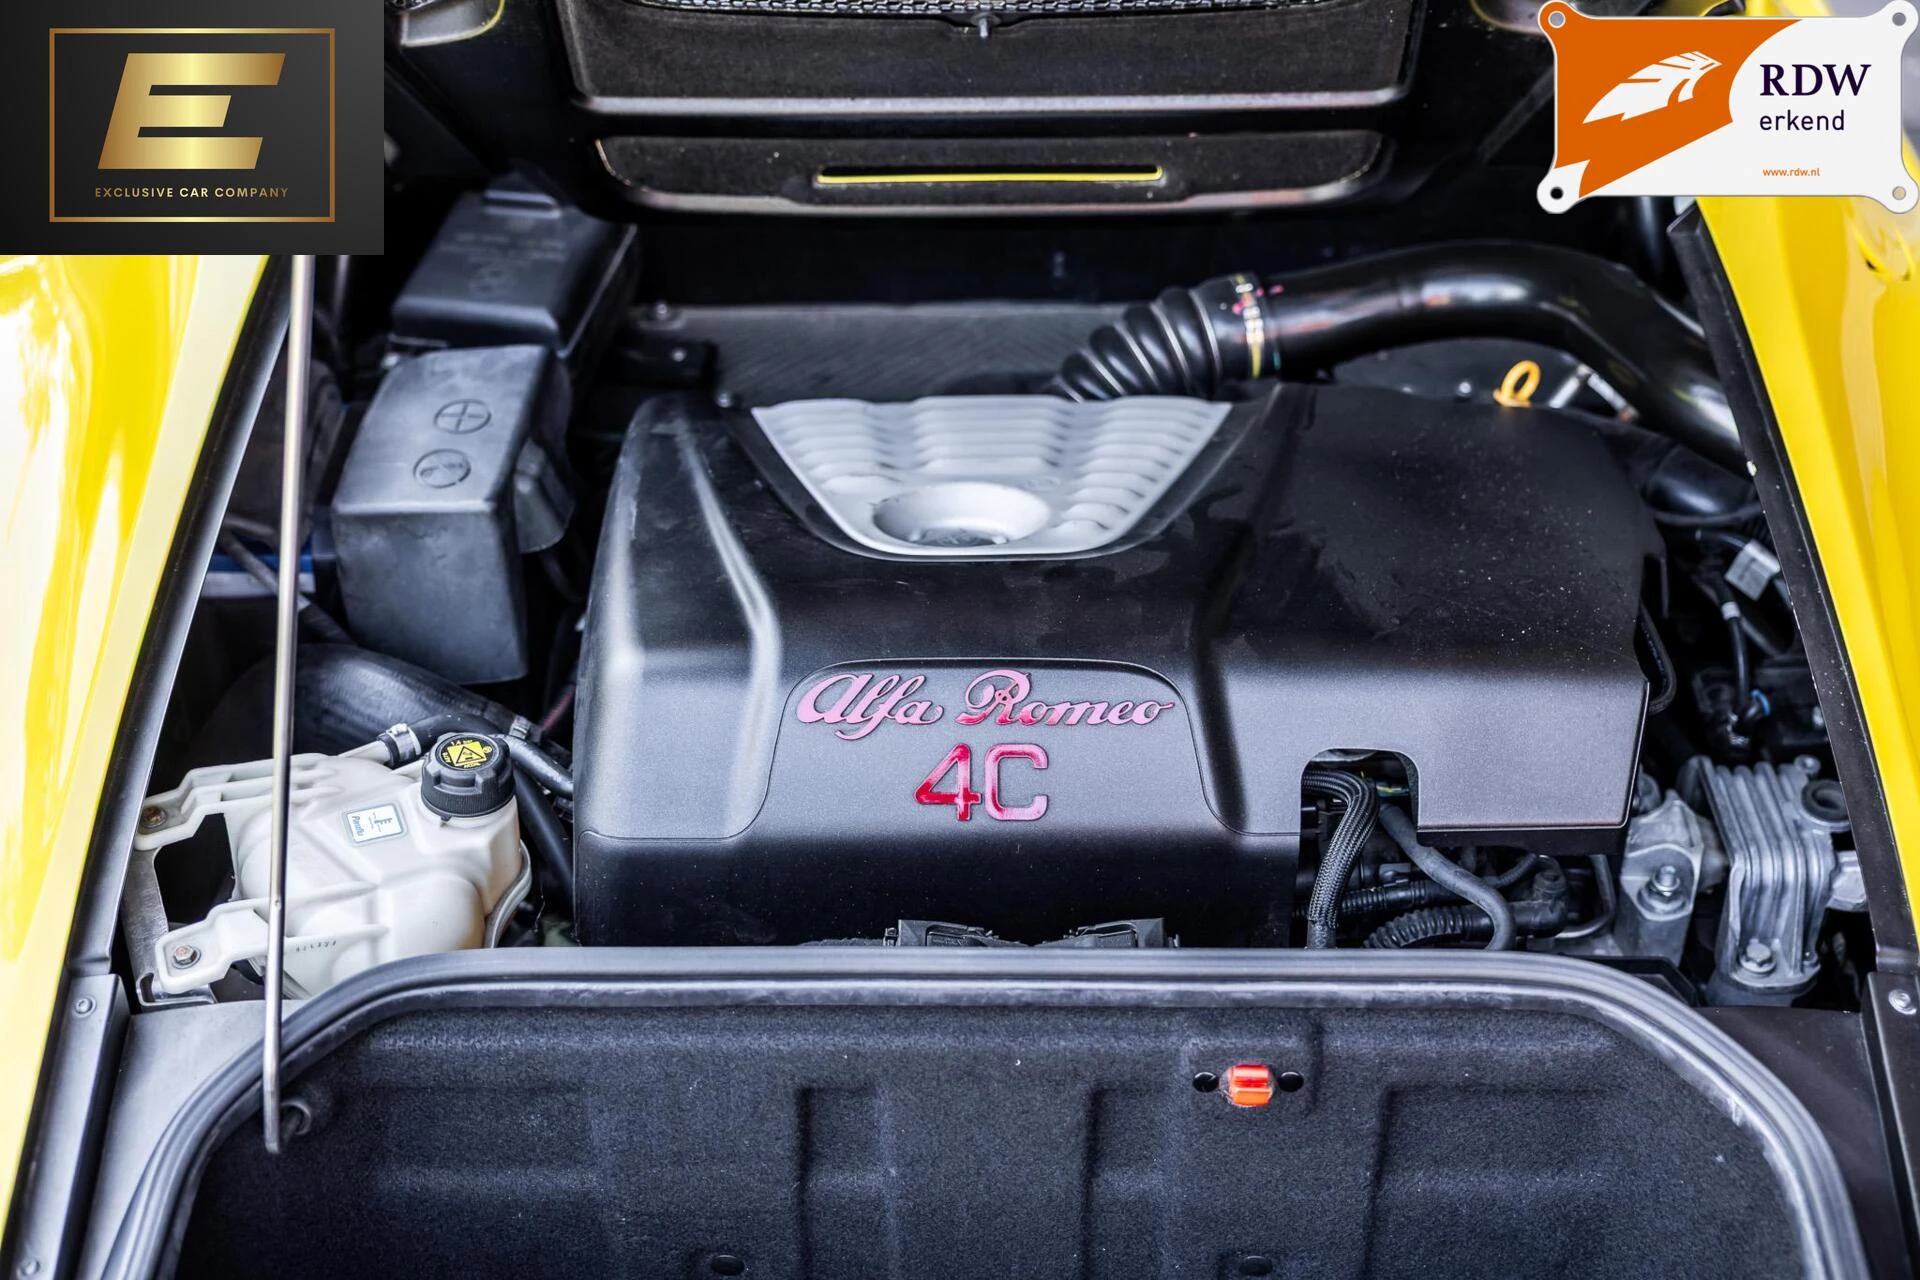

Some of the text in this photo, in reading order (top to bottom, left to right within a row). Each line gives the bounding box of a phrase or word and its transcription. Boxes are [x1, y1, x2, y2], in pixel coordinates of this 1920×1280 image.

[796, 668, 1175, 741] Alfa Romeo
[913, 742, 1049, 822] 4C
